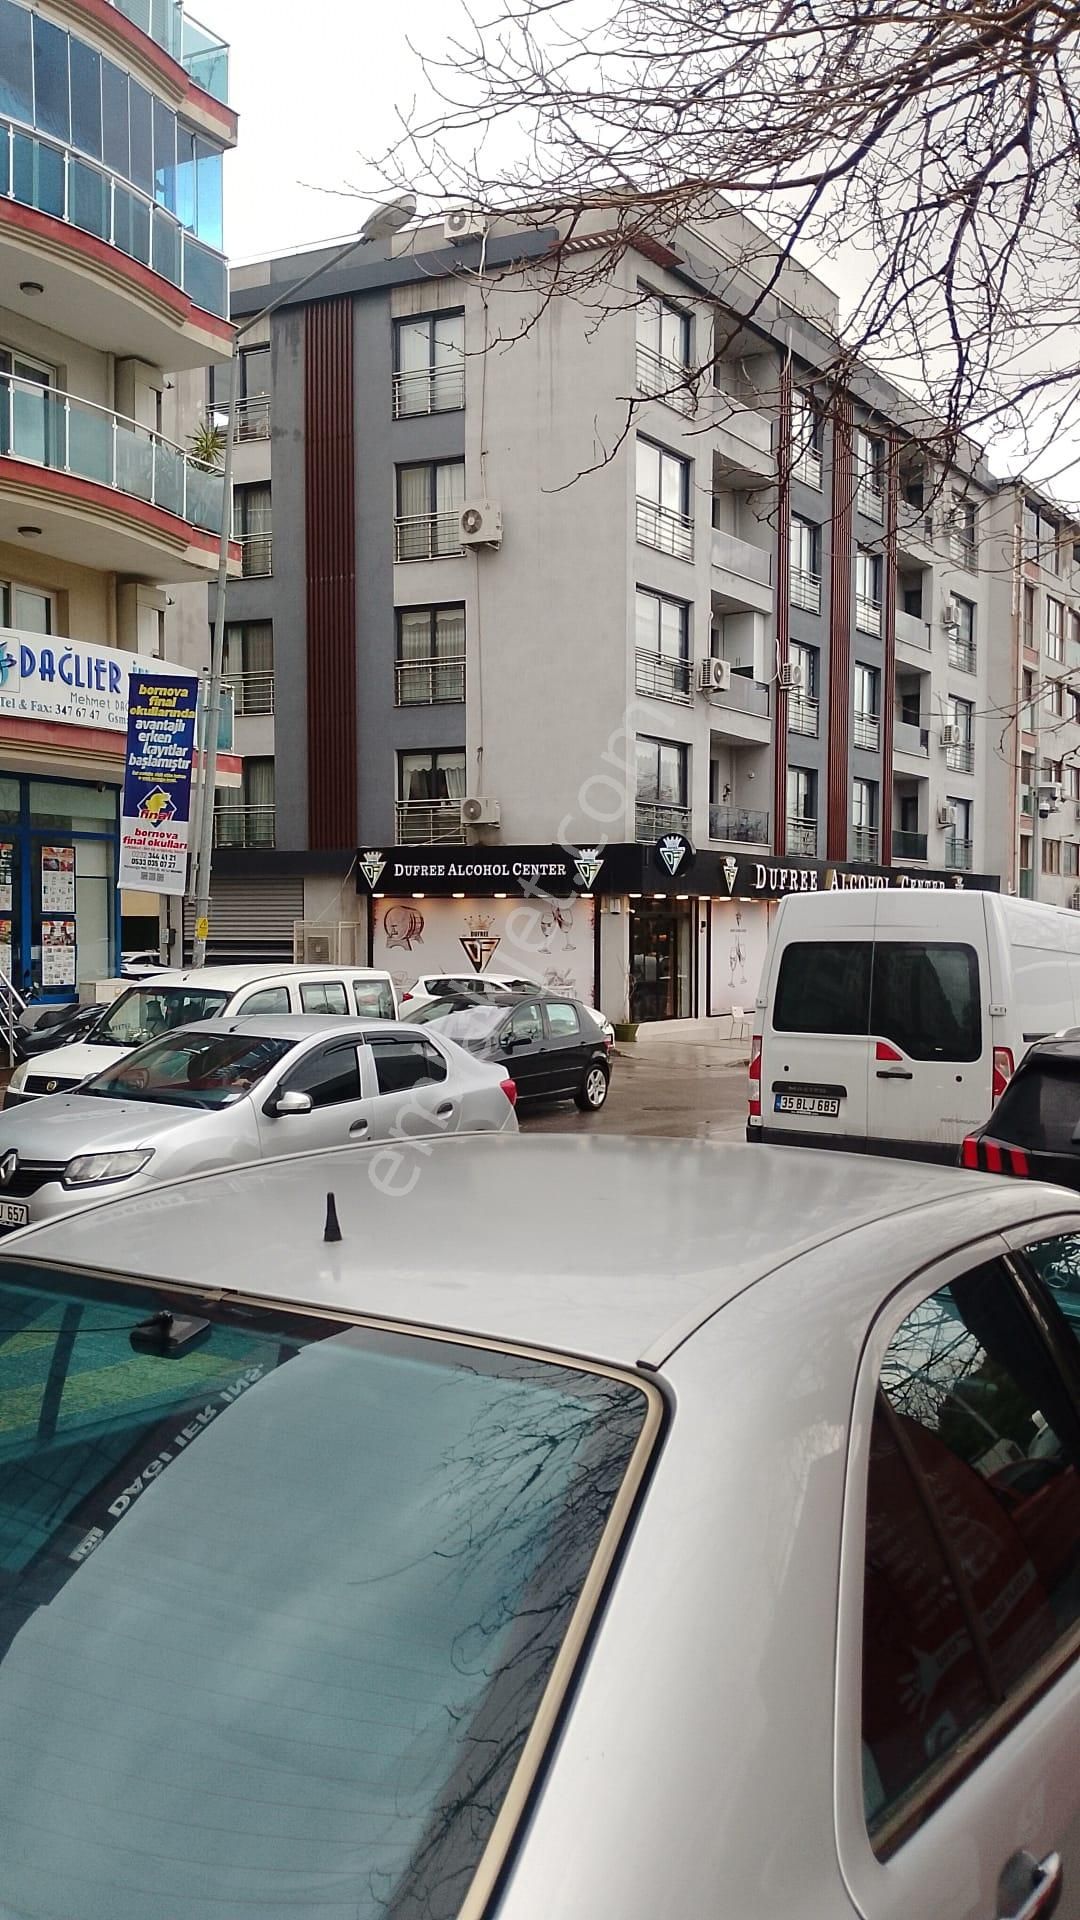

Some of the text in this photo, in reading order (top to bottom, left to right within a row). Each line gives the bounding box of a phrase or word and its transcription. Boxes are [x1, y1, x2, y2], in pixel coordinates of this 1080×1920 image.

[20, 644, 121, 694] DAĞLIER
[138, 684, 189, 697] bornova
[149, 695, 177, 707] final
[0, 697, 15, 708] Tel
[19, 699, 27, 710] &
[31, 701, 53, 713] Fax:
[55, 704, 73, 715] 347
[76, 708, 86, 717] 67
[90, 710, 100, 720] 47
[129, 706, 196, 718] okullarında
[135, 719, 186, 734] avantajlı
[138, 730, 172, 743] erken
[142, 742, 189, 757] kayıtlar
[128, 753, 192, 771] başlamıştır
[139, 808, 173, 820] final
[134, 828, 179, 839] bornova
[122, 836, 188, 849] final okulları
[394, 863, 445, 876] DUFREE
[447, 863, 510, 876] ALCOHOL
[512, 862, 567, 876] CENTER
[755, 864, 818, 891] DUFREE
[781, 1097, 836, 1112] 35 BLJ 685
[8, 1206, 25, 1222] 657
